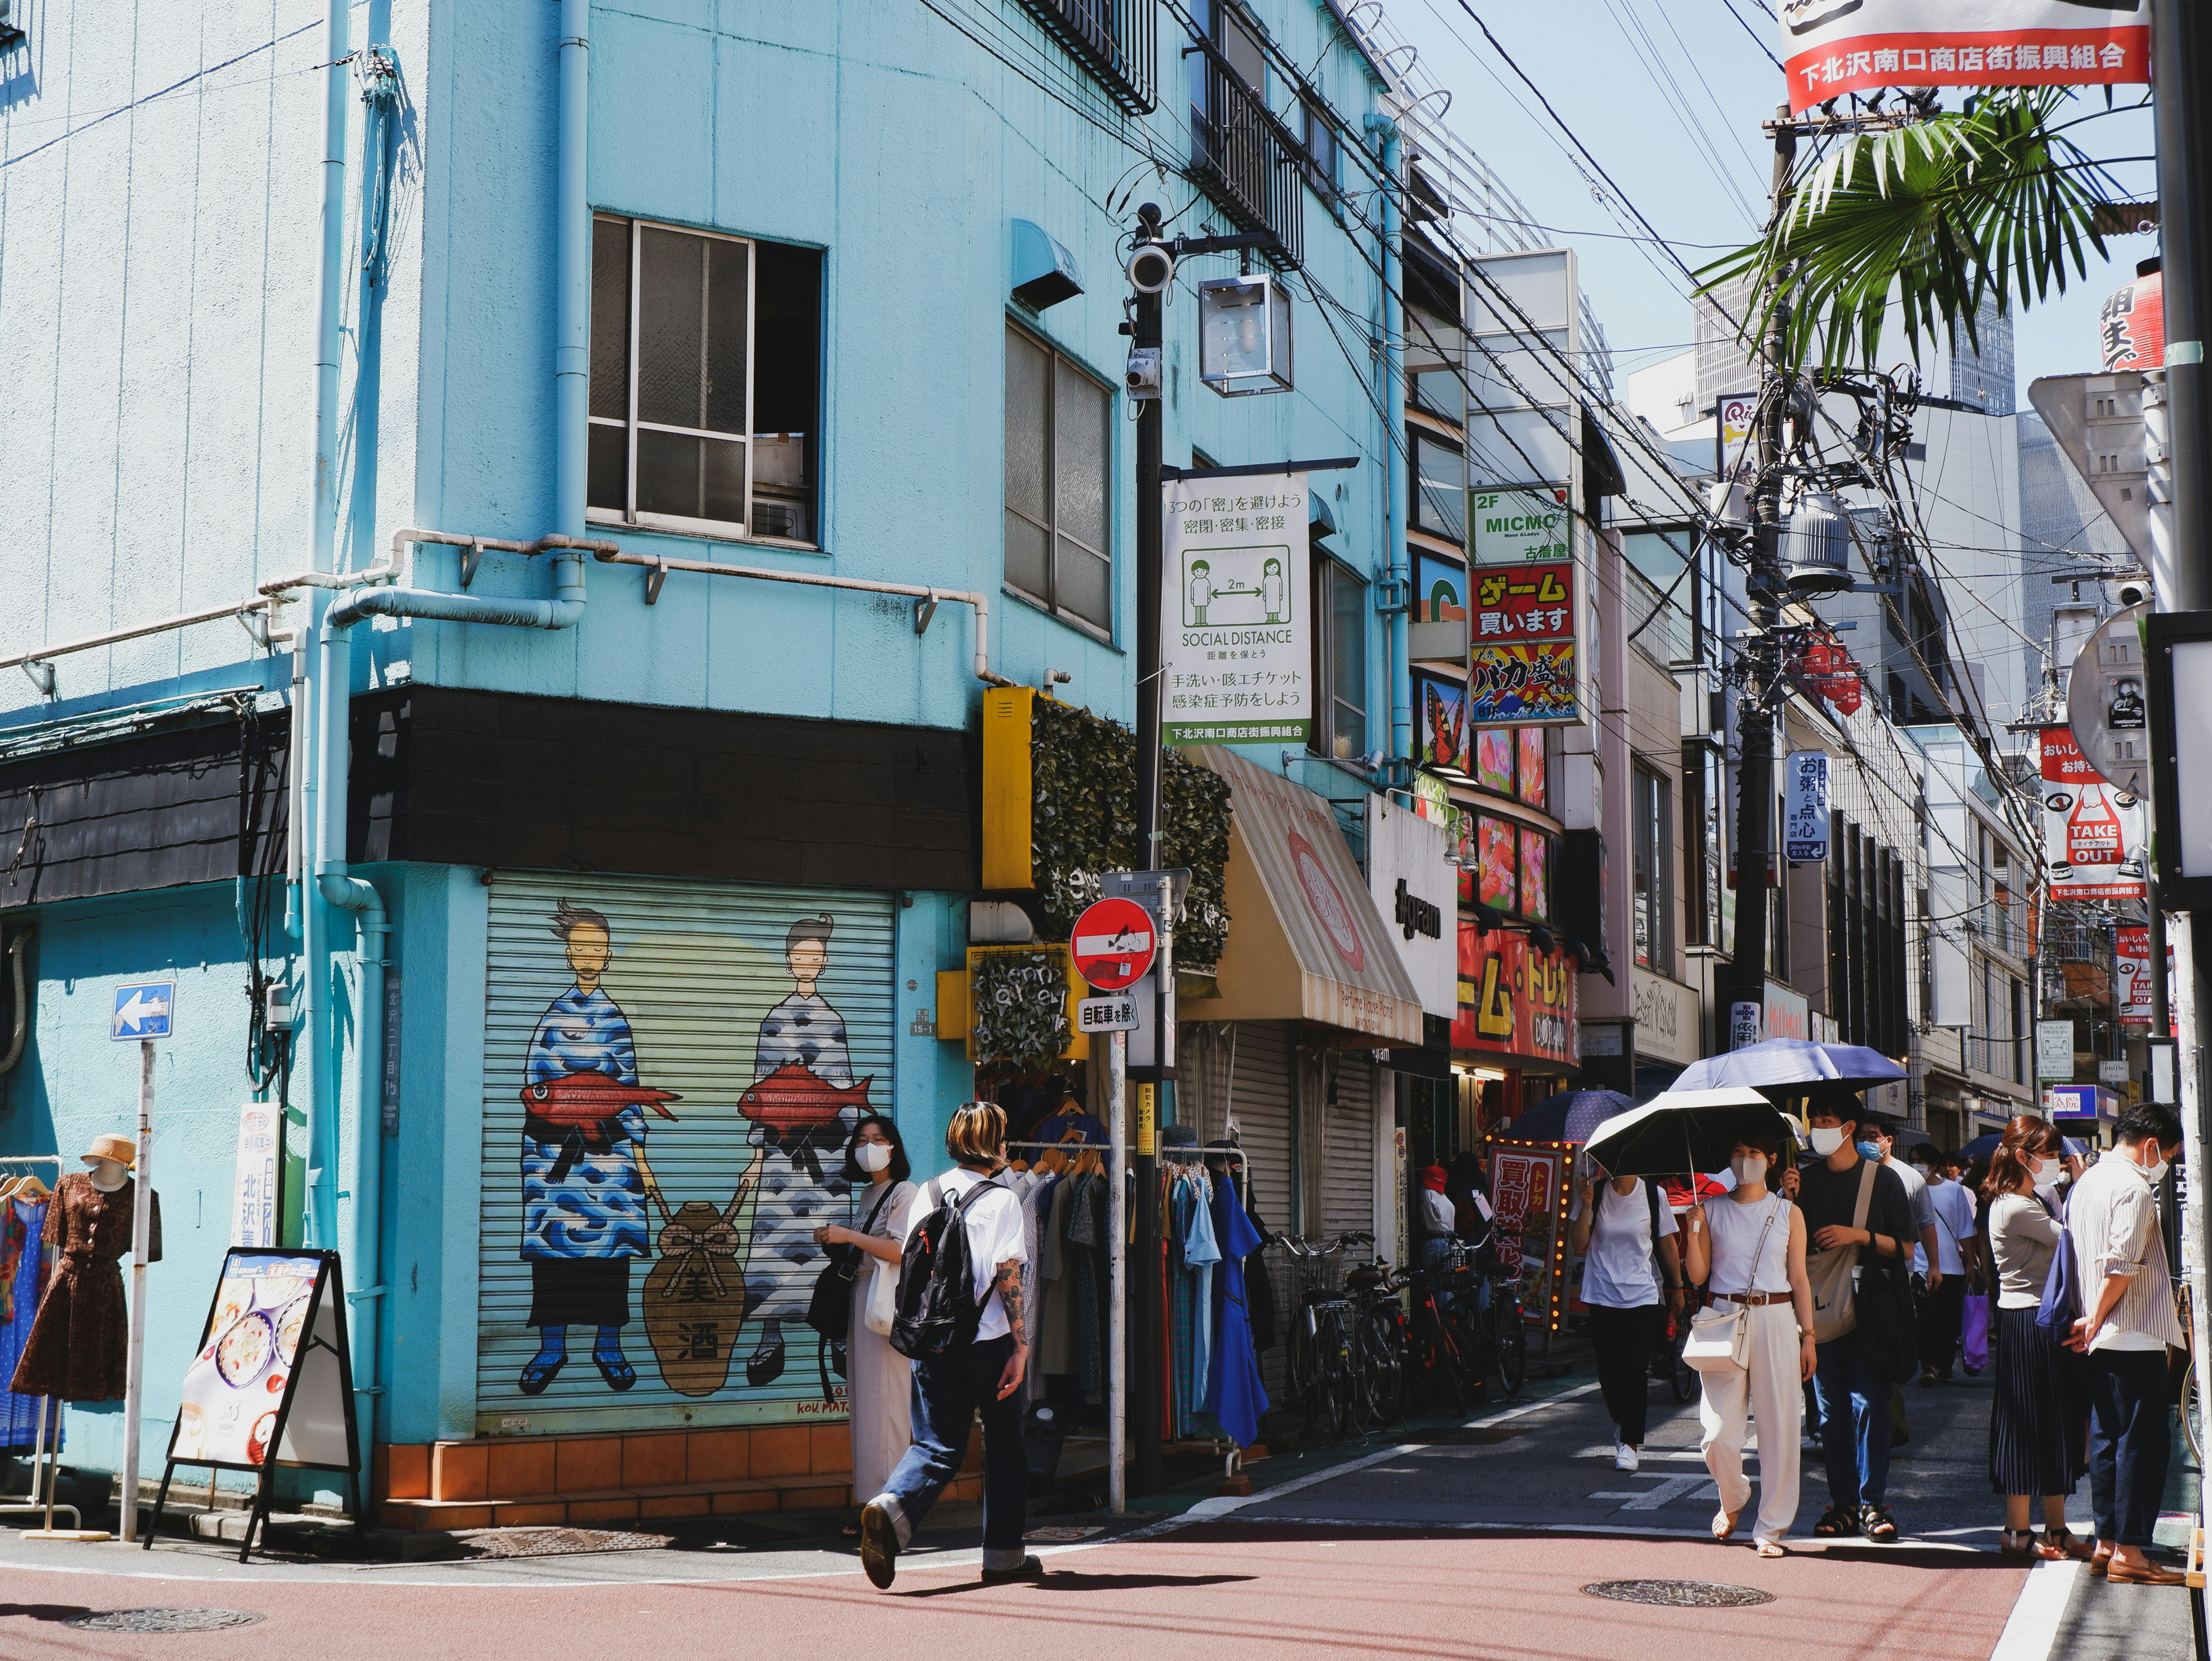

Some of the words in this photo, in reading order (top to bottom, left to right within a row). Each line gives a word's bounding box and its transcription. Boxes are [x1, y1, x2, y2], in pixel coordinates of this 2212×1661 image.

[1800, 43, 2126, 92] 下北沢南口商店街振興組合
[1169, 494, 1301, 514] 3つの「密」を避けよう
[1477, 496, 1498, 509] 2F
[1184, 516, 1285, 534] 密閉・密集・密接
[1524, 544, 1566, 560] 古着屋
[1228, 579, 1245, 589] 2m
[1480, 574, 1566, 606] ゲーム
[1480, 607, 1568, 635] 買います
[1182, 632, 1228, 647] SOCIAL
[1232, 630, 1292, 645] DISTANCE
[1207, 650, 1266, 660] 距離を保とう
[1476, 649, 1495, 661] 大衆
[1170, 671, 1301, 688] 手洗い・咳エチケット
[1172, 692, 1300, 708] 感染症予防をしよう
[1172, 725, 1302, 739] 下北沢南口商店街振興組合
[1798, 758, 1817, 838] お粥と点心
[2070, 825, 2117, 838] TAKE
[2075, 850, 2114, 862] OUT
[1395, 878, 1441, 940] #gram
[1342, 990, 1362, 1010] Perfume
[1364, 997, 1378, 1014] House
[1084, 1003, 1135, 1025] 自転車を除く
[388, 993, 397, 1075] 北沢二丁目
[914, 1025, 932, 1033] 15-1
[385, 1080, 397, 1096] 15
[1532, 1170, 1545, 1205] トレカ
[677, 1266, 719, 1359] 美酒
